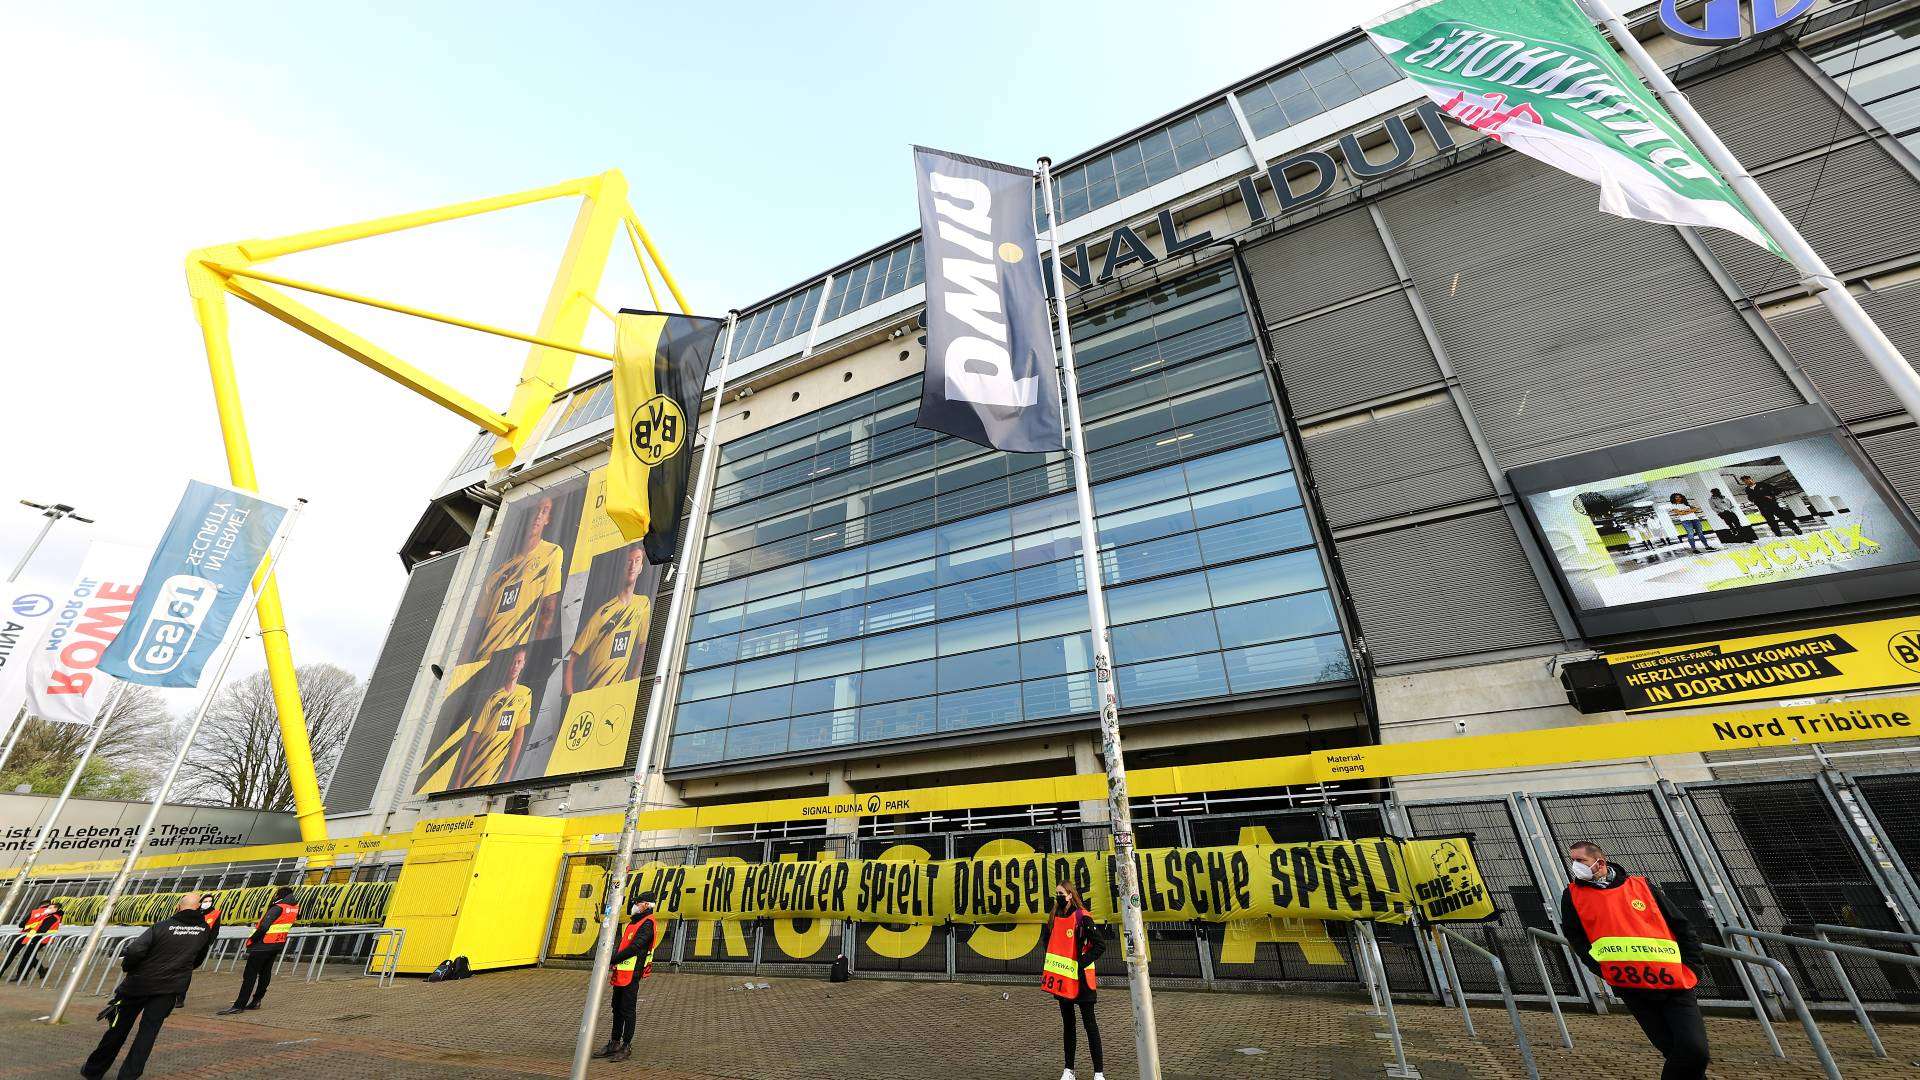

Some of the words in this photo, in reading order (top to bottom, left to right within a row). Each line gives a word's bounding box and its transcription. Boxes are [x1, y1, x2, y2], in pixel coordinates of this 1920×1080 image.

[1728, 523, 1880, 574] MCMIX
[614, 636, 629, 651] 1&1
[1625, 662, 1709, 686] HERZLICH
[1710, 639, 1836, 671] WILLKOMMEN
[1632, 660, 1658, 670] LIEBE
[1645, 685, 1673, 702] IN
[1674, 660, 1822, 698] DORTMUND!
[568, 712, 593, 740] BVB
[1712, 717, 1785, 742] Nord
[1787, 709, 1912, 735] Tribüne
[1327, 754, 1364, 763] Material-
[1332, 765, 1364, 773] eingang
[802, 806, 832, 816] SIGNAL
[834, 804, 863, 814] IDUNA
[885, 799, 910, 810] PARK
[6, 826, 31, 838] ist
[64, 825, 120, 838] Leben
[161, 824, 222, 836] Theorie,
[425, 819, 474, 833] Clearingstelle
[199, 834, 242, 846] Platz!
[1631, 945, 1676, 954] STEWARD
[1609, 966, 1674, 985] 2866
